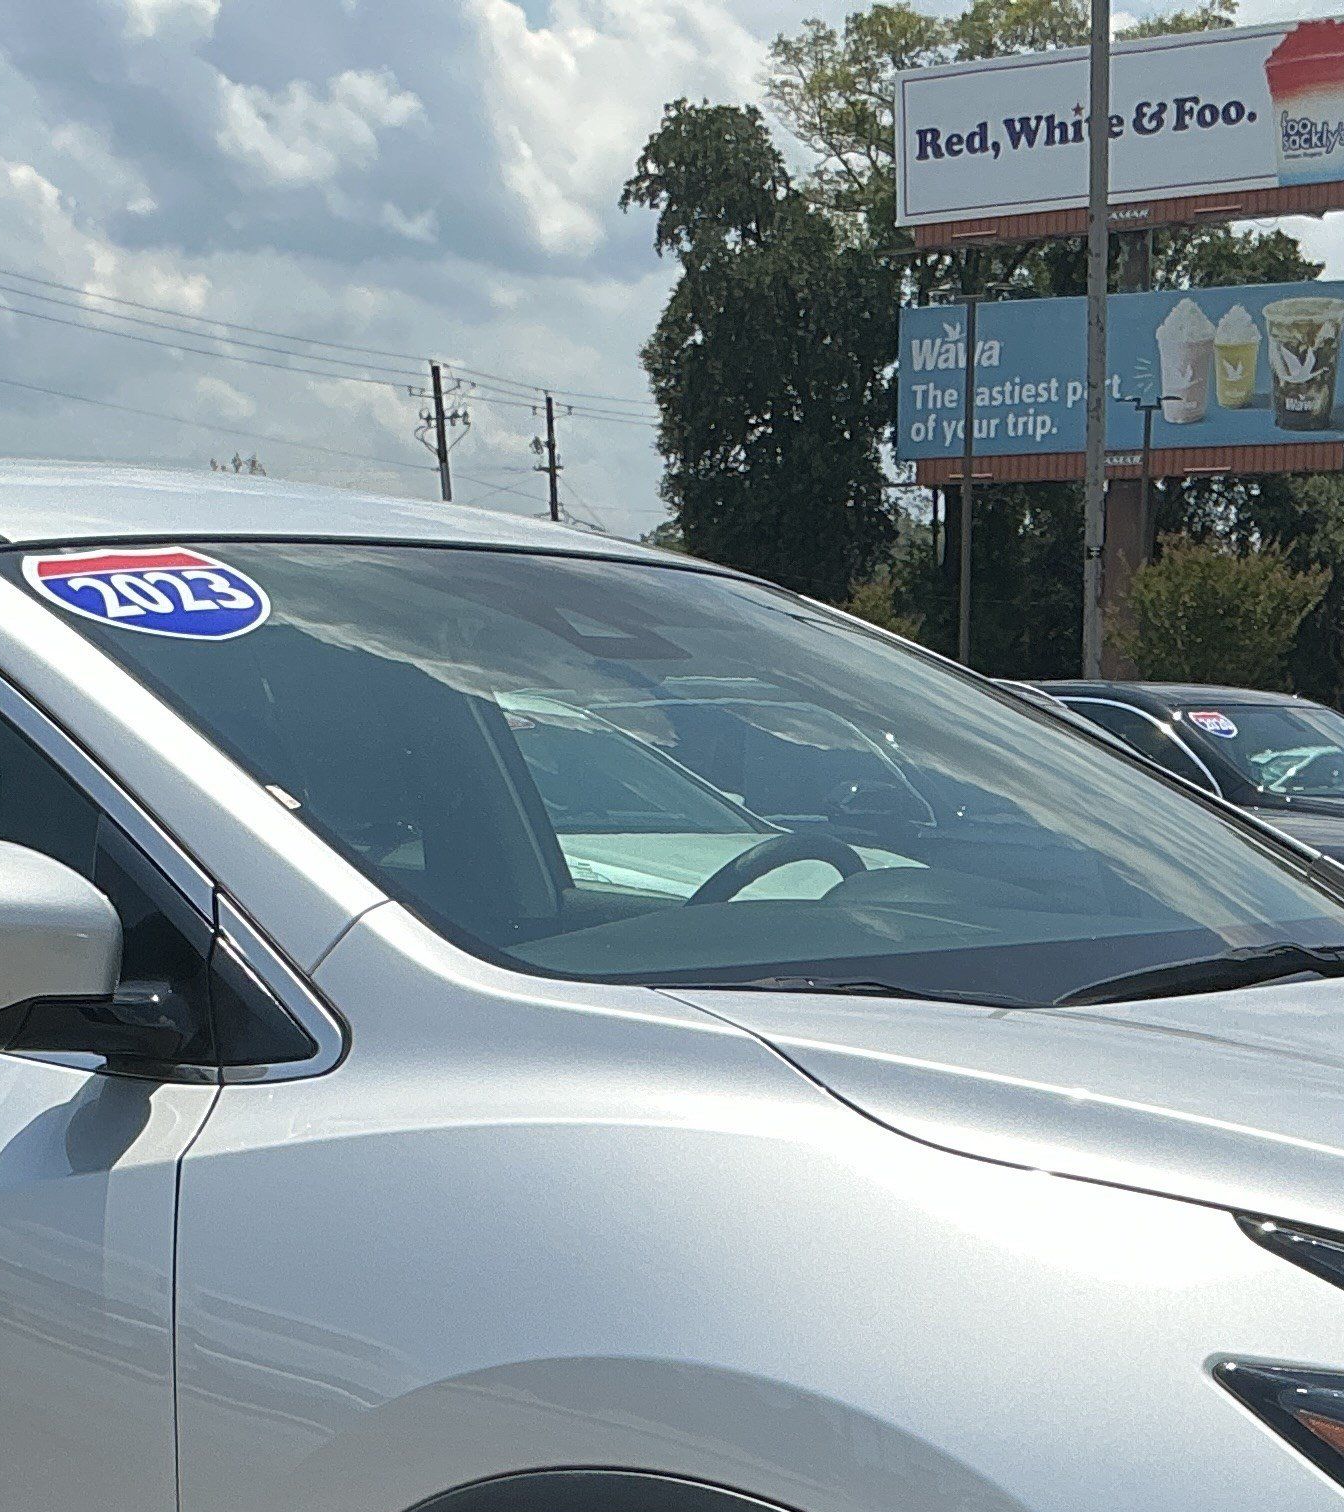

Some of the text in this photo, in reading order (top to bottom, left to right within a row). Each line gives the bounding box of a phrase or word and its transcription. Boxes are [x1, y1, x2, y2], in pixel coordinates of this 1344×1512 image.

[915, 96, 1257, 160] Red, Whie & Foo.
[911, 374, 1122, 410] The astiest pt
[911, 414, 937, 443] of
[1007, 408, 1058, 442] trip.
[67, 570, 255, 619] 2023
